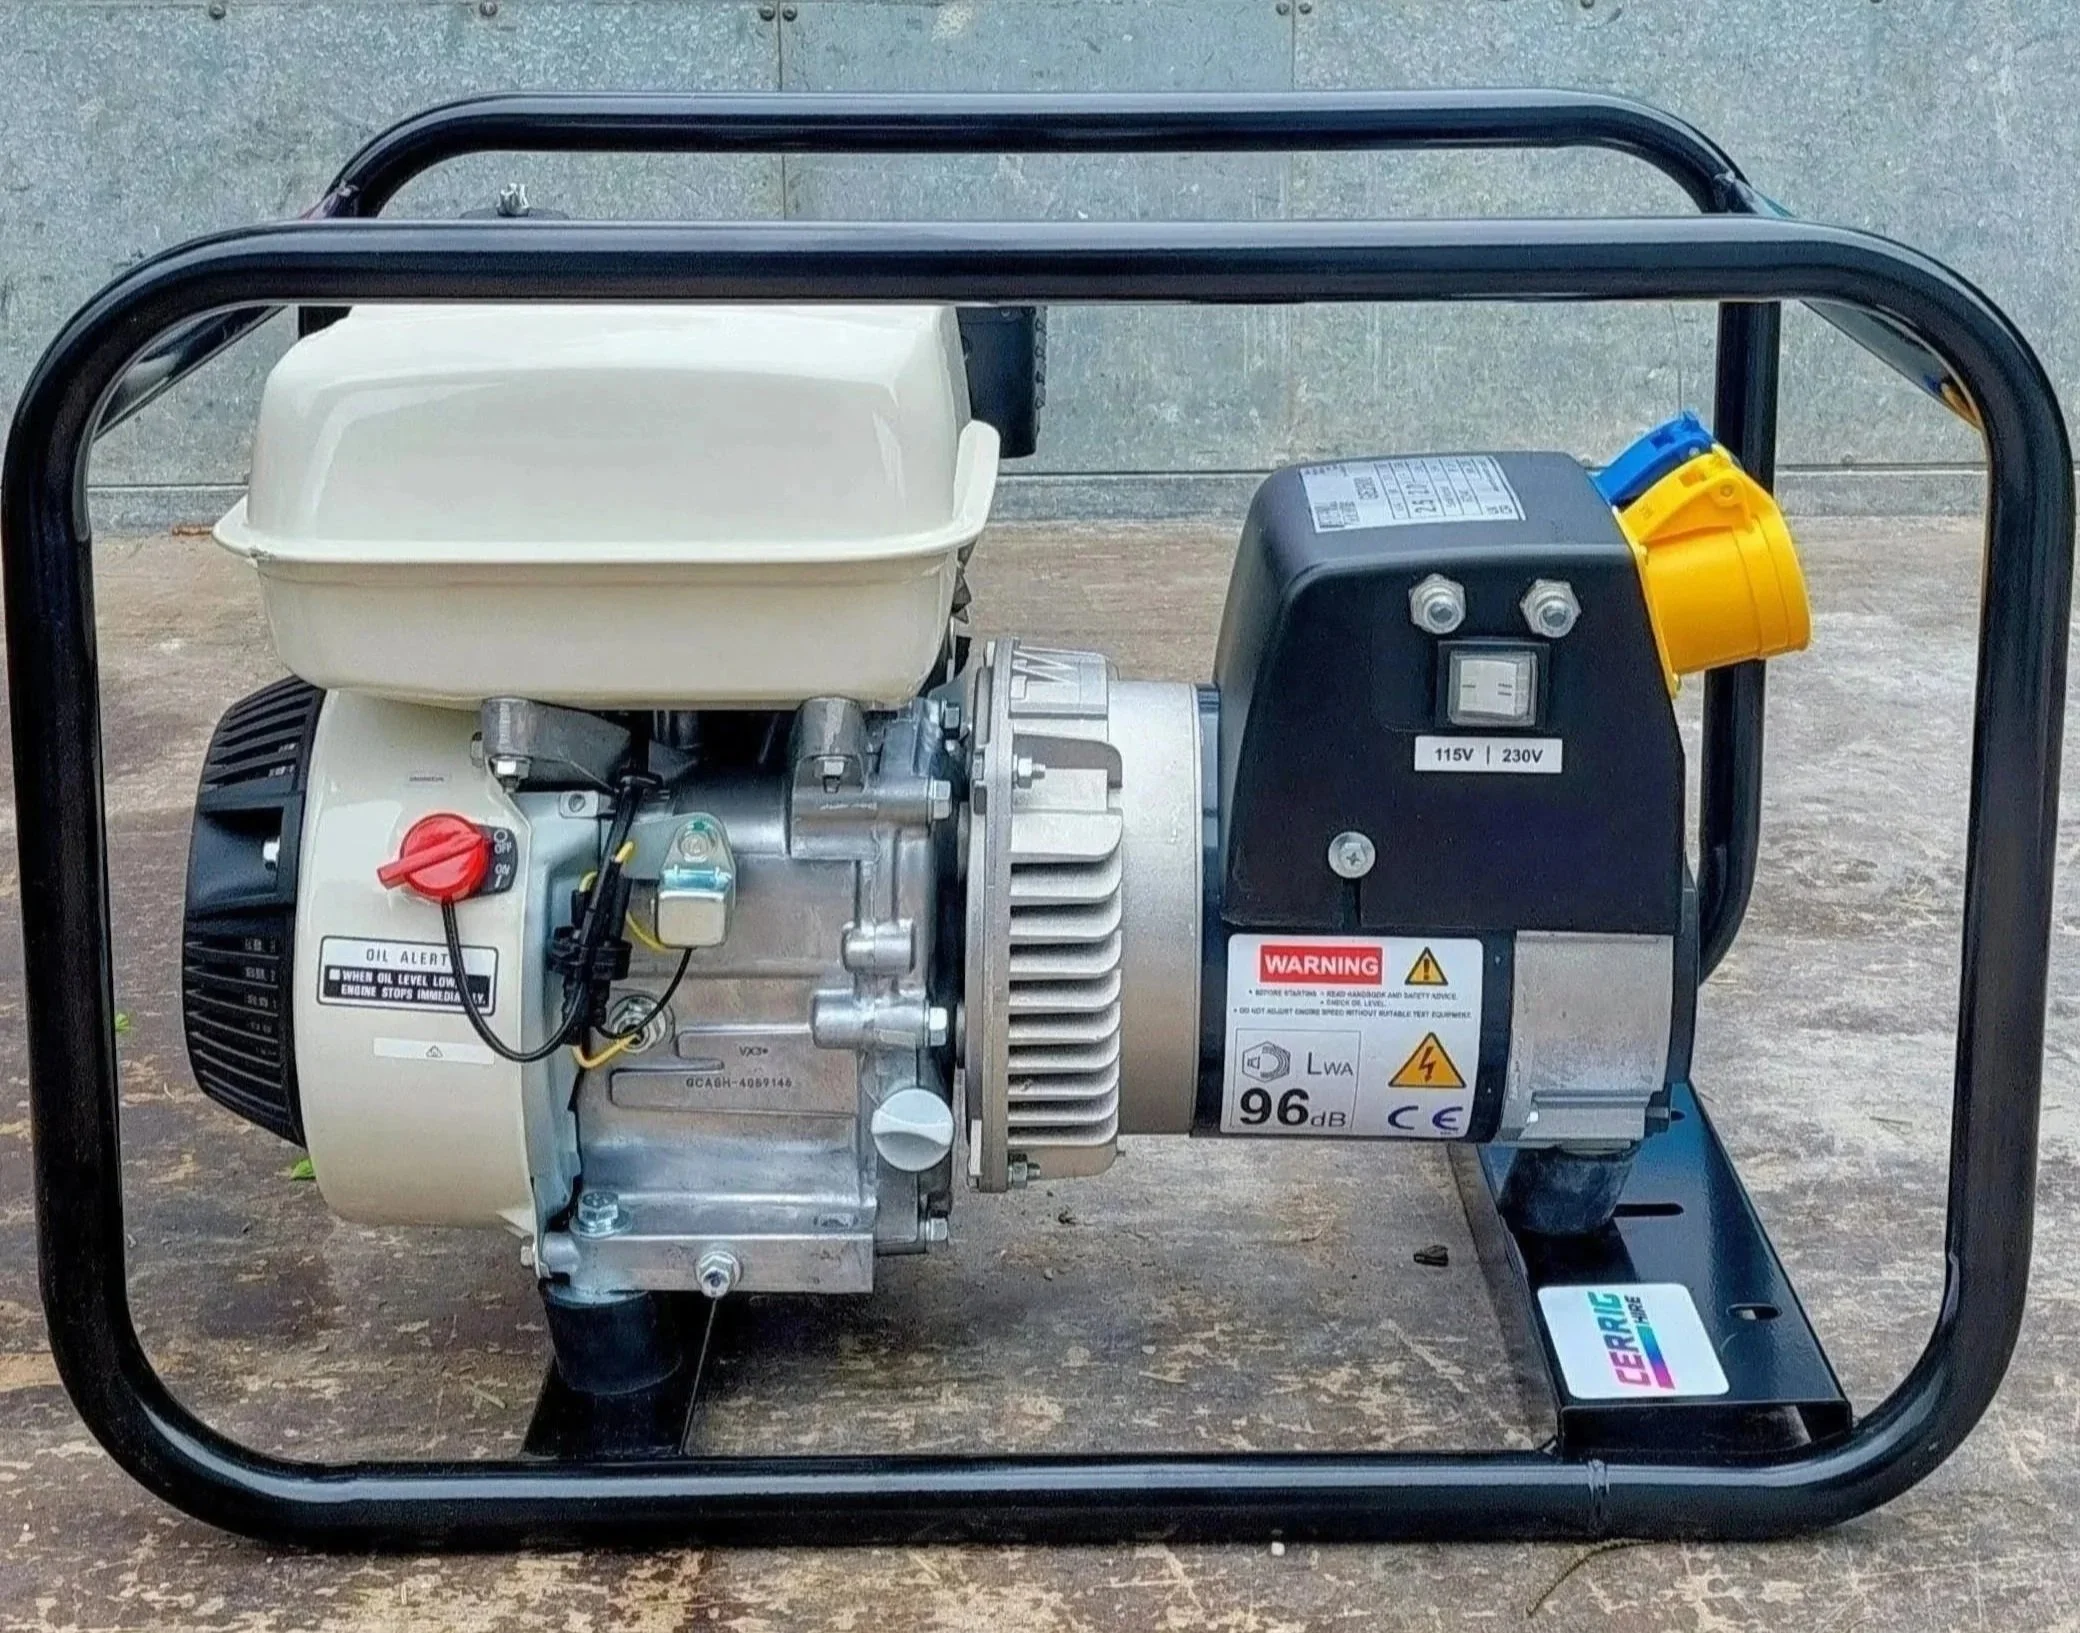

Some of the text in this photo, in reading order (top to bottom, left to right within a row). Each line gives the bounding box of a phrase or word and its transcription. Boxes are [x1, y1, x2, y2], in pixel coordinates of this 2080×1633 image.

[1434, 748, 1543, 763] 115V 230V
[495, 863, 510, 875] ON
[366, 948, 449, 966] OIL ALERT
[1264, 954, 1378, 976] WARNING
[343, 968, 373, 983] WHEN
[378, 972, 393, 984] OIL
[398, 974, 428, 987] LEVEL
[341, 984, 376, 997] ENGINE
[381, 987, 412, 999] STOPS
[1624, 1296, 1650, 1324] HIRE
[1587, 1291, 1651, 1386] CERRIG
